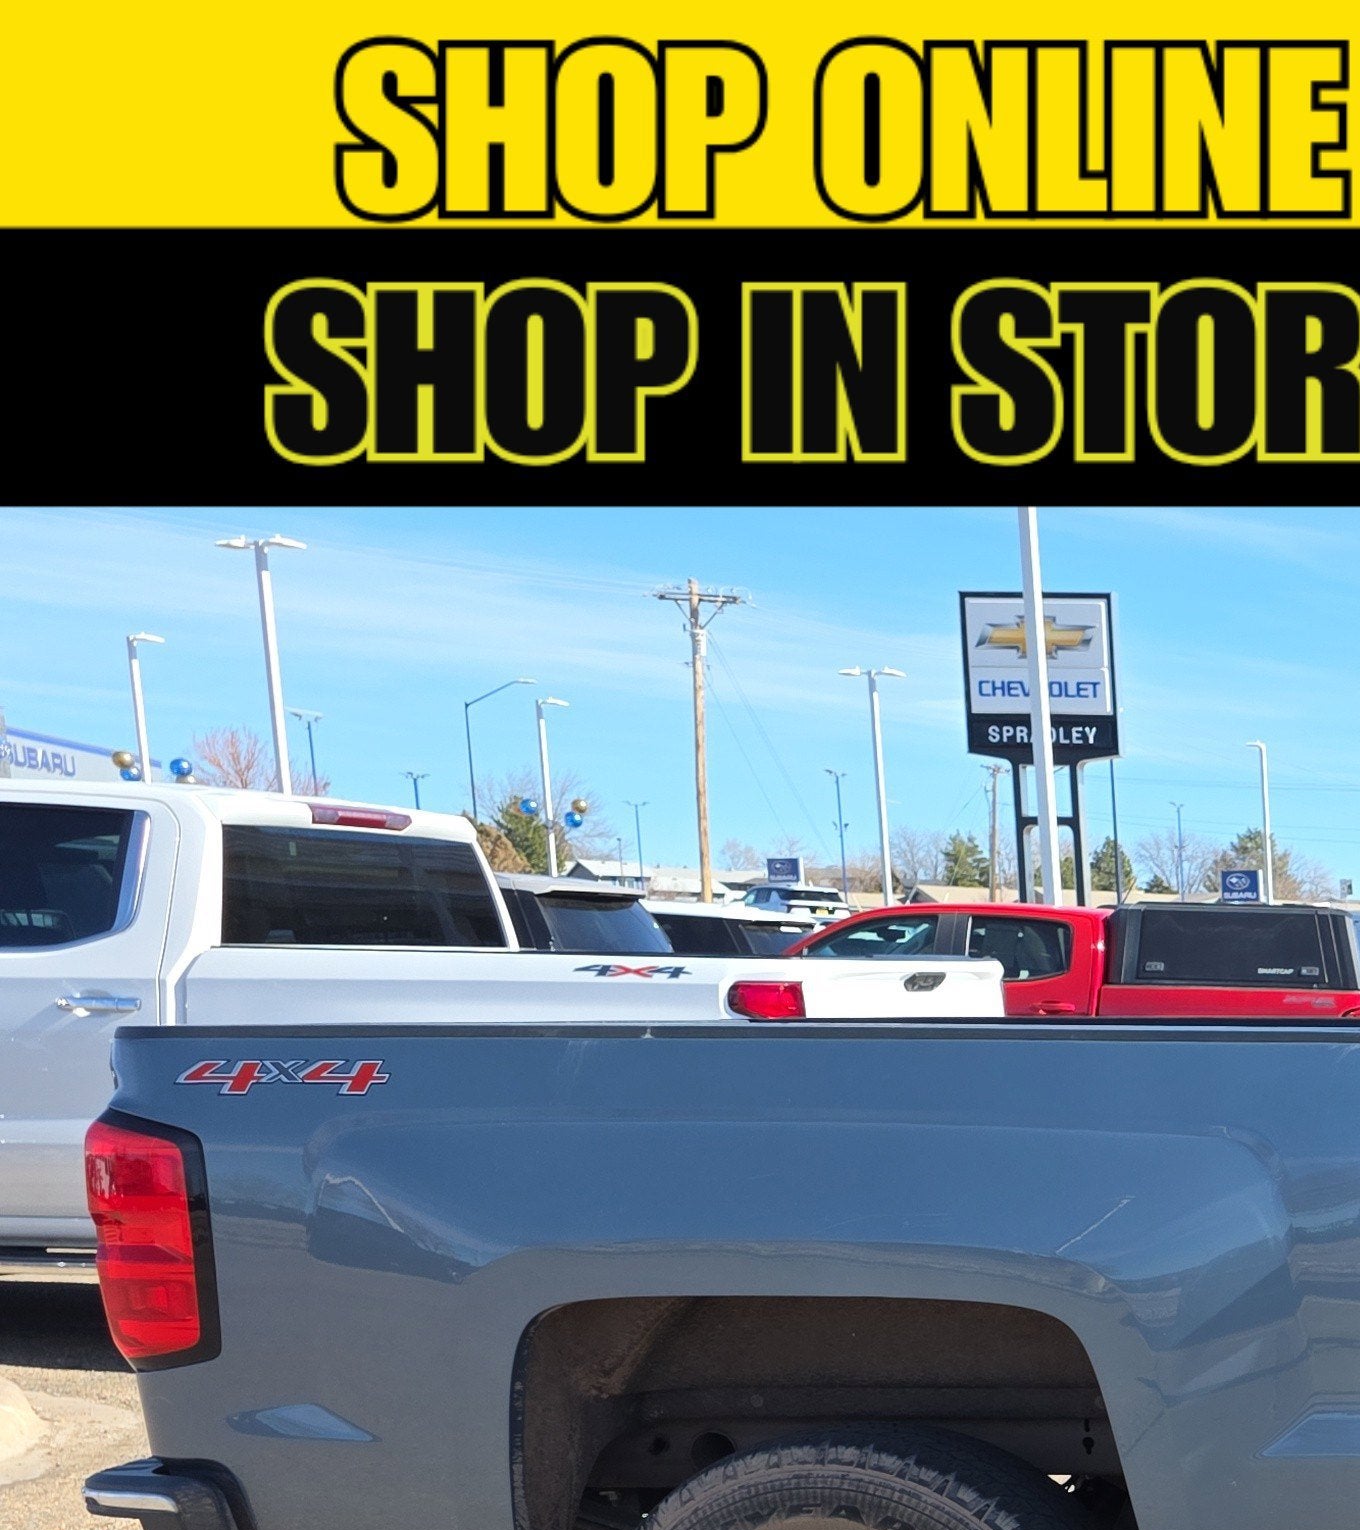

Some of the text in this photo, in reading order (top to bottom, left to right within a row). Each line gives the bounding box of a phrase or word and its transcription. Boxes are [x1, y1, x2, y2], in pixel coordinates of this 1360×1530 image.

[978, 680, 1100, 698] CHEVOLET
[988, 725, 1097, 744] SPRLEY
[1223, 891, 1257, 899] SUBARU
